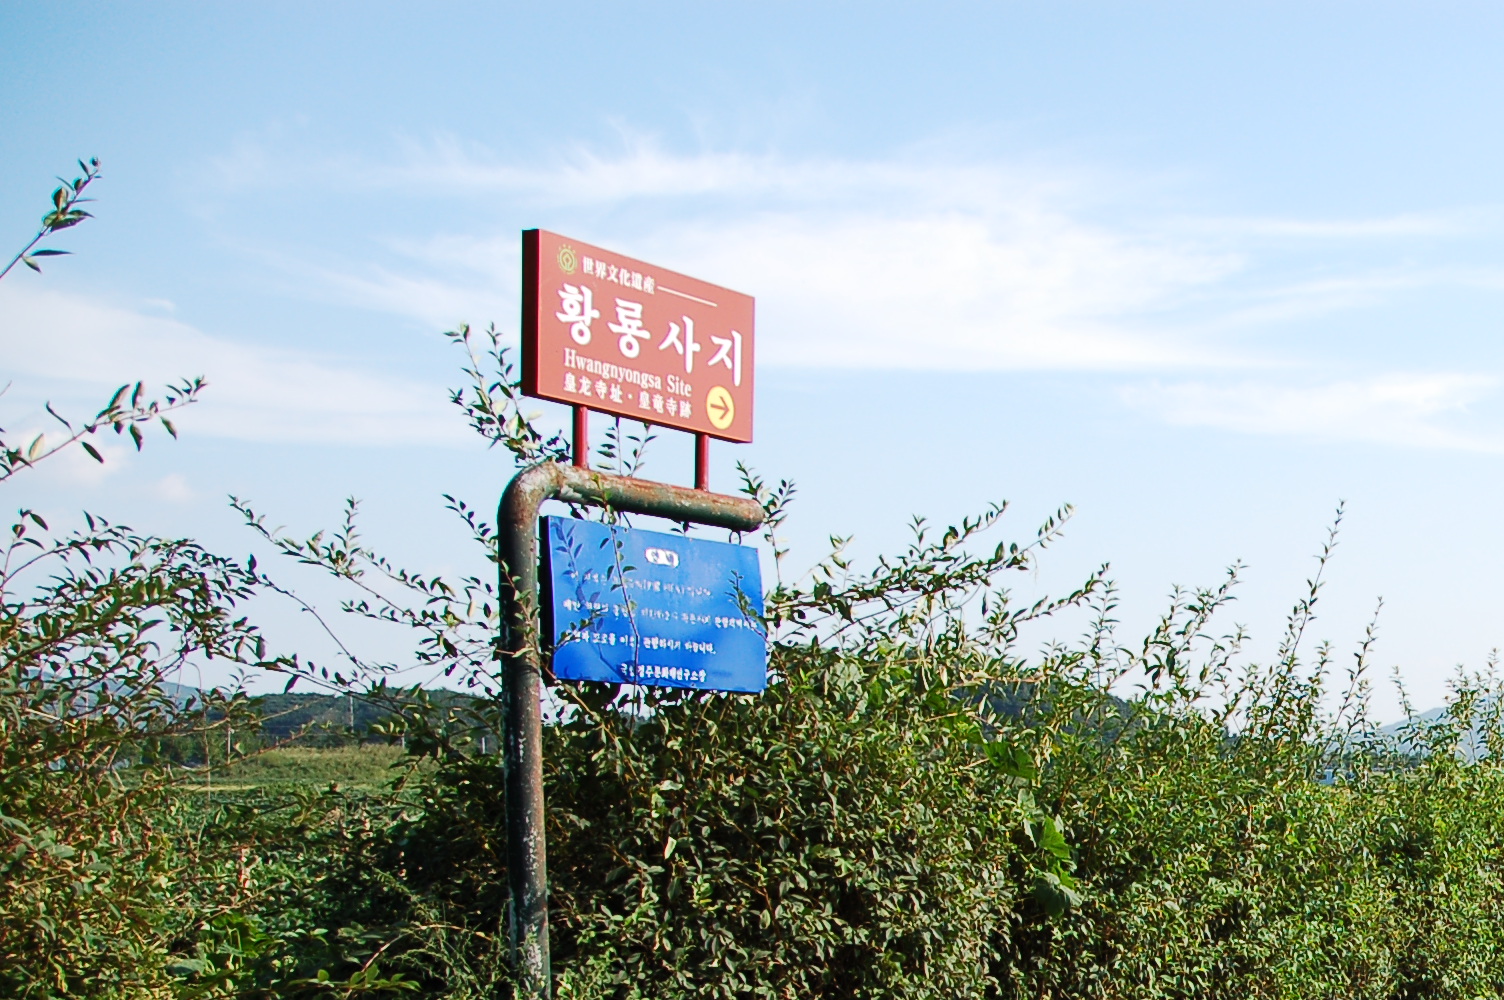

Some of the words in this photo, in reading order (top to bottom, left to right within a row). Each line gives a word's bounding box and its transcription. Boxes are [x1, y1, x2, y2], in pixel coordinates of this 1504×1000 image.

[555, 283, 742, 387] 황룡사지
[563, 348, 662, 390] Hwangnyongsa
[666, 374, 692, 398] Site
